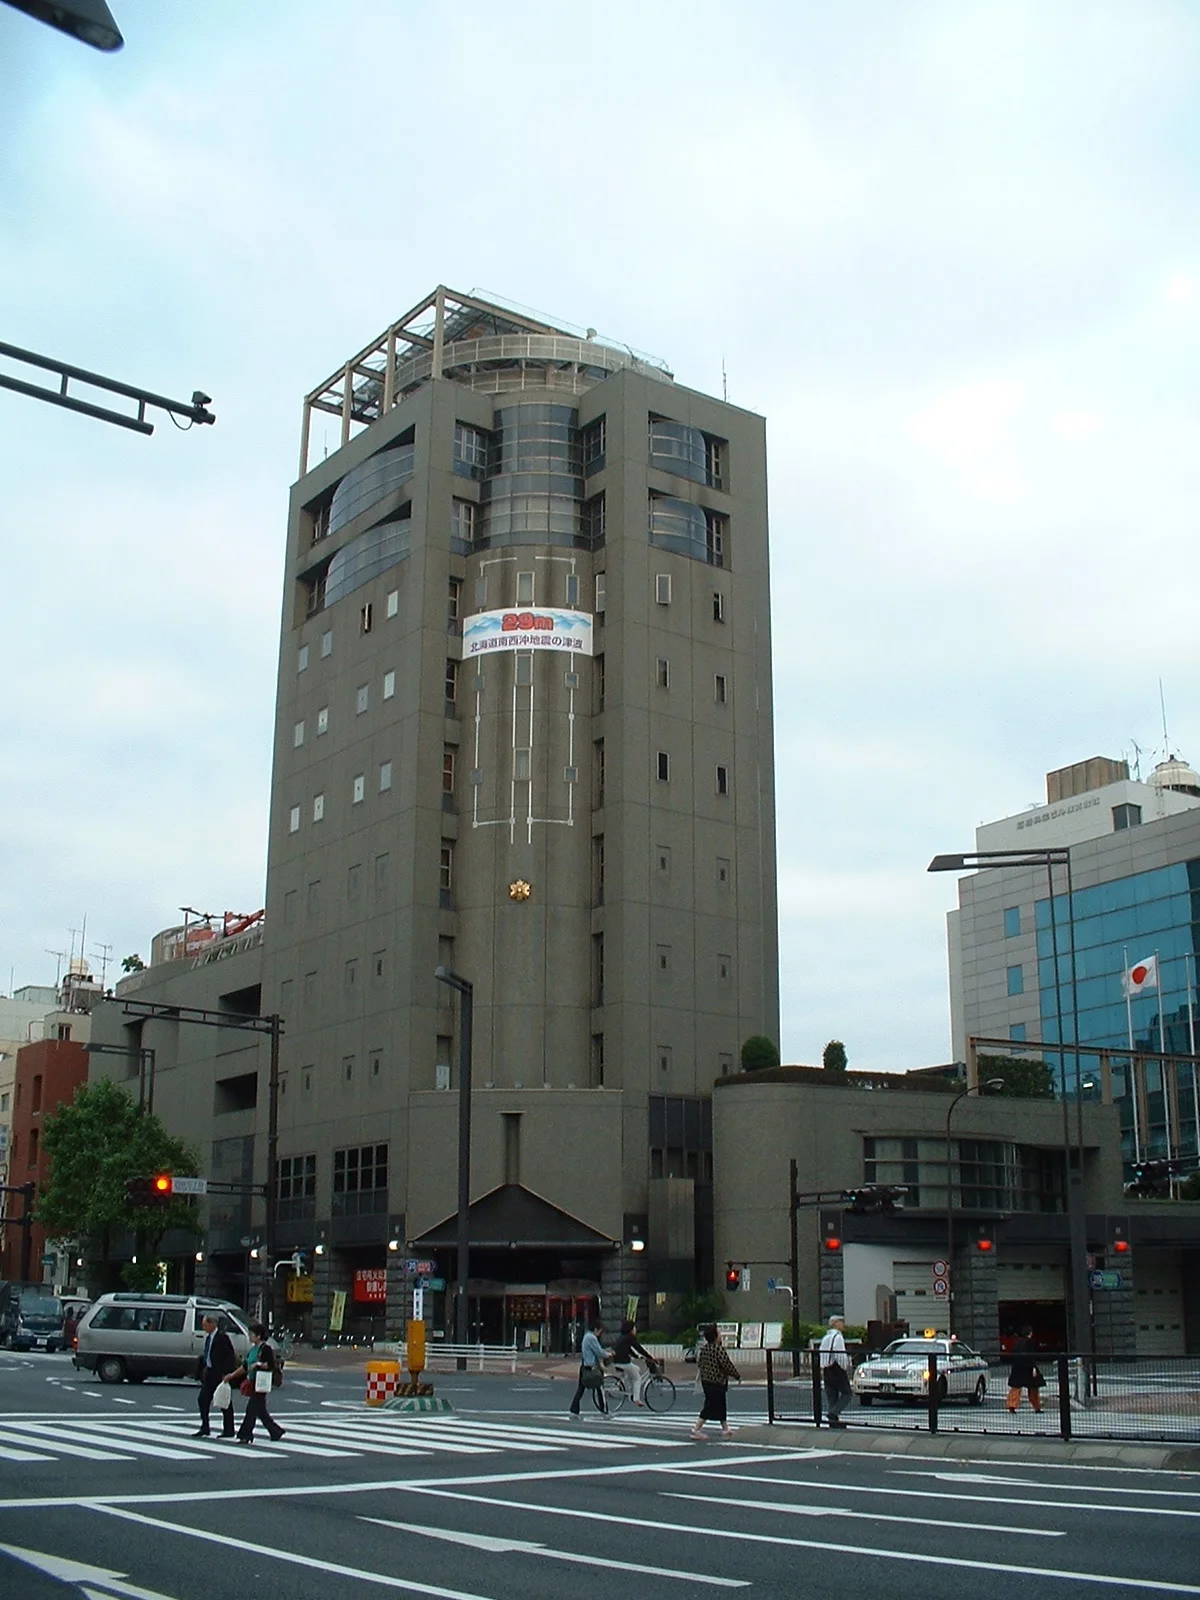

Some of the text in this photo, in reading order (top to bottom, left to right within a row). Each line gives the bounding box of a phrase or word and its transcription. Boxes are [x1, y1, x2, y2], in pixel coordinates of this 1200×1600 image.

[502, 612, 553, 631] 29m
[470, 634, 583, 653] 北海道南西沖地震の津波
